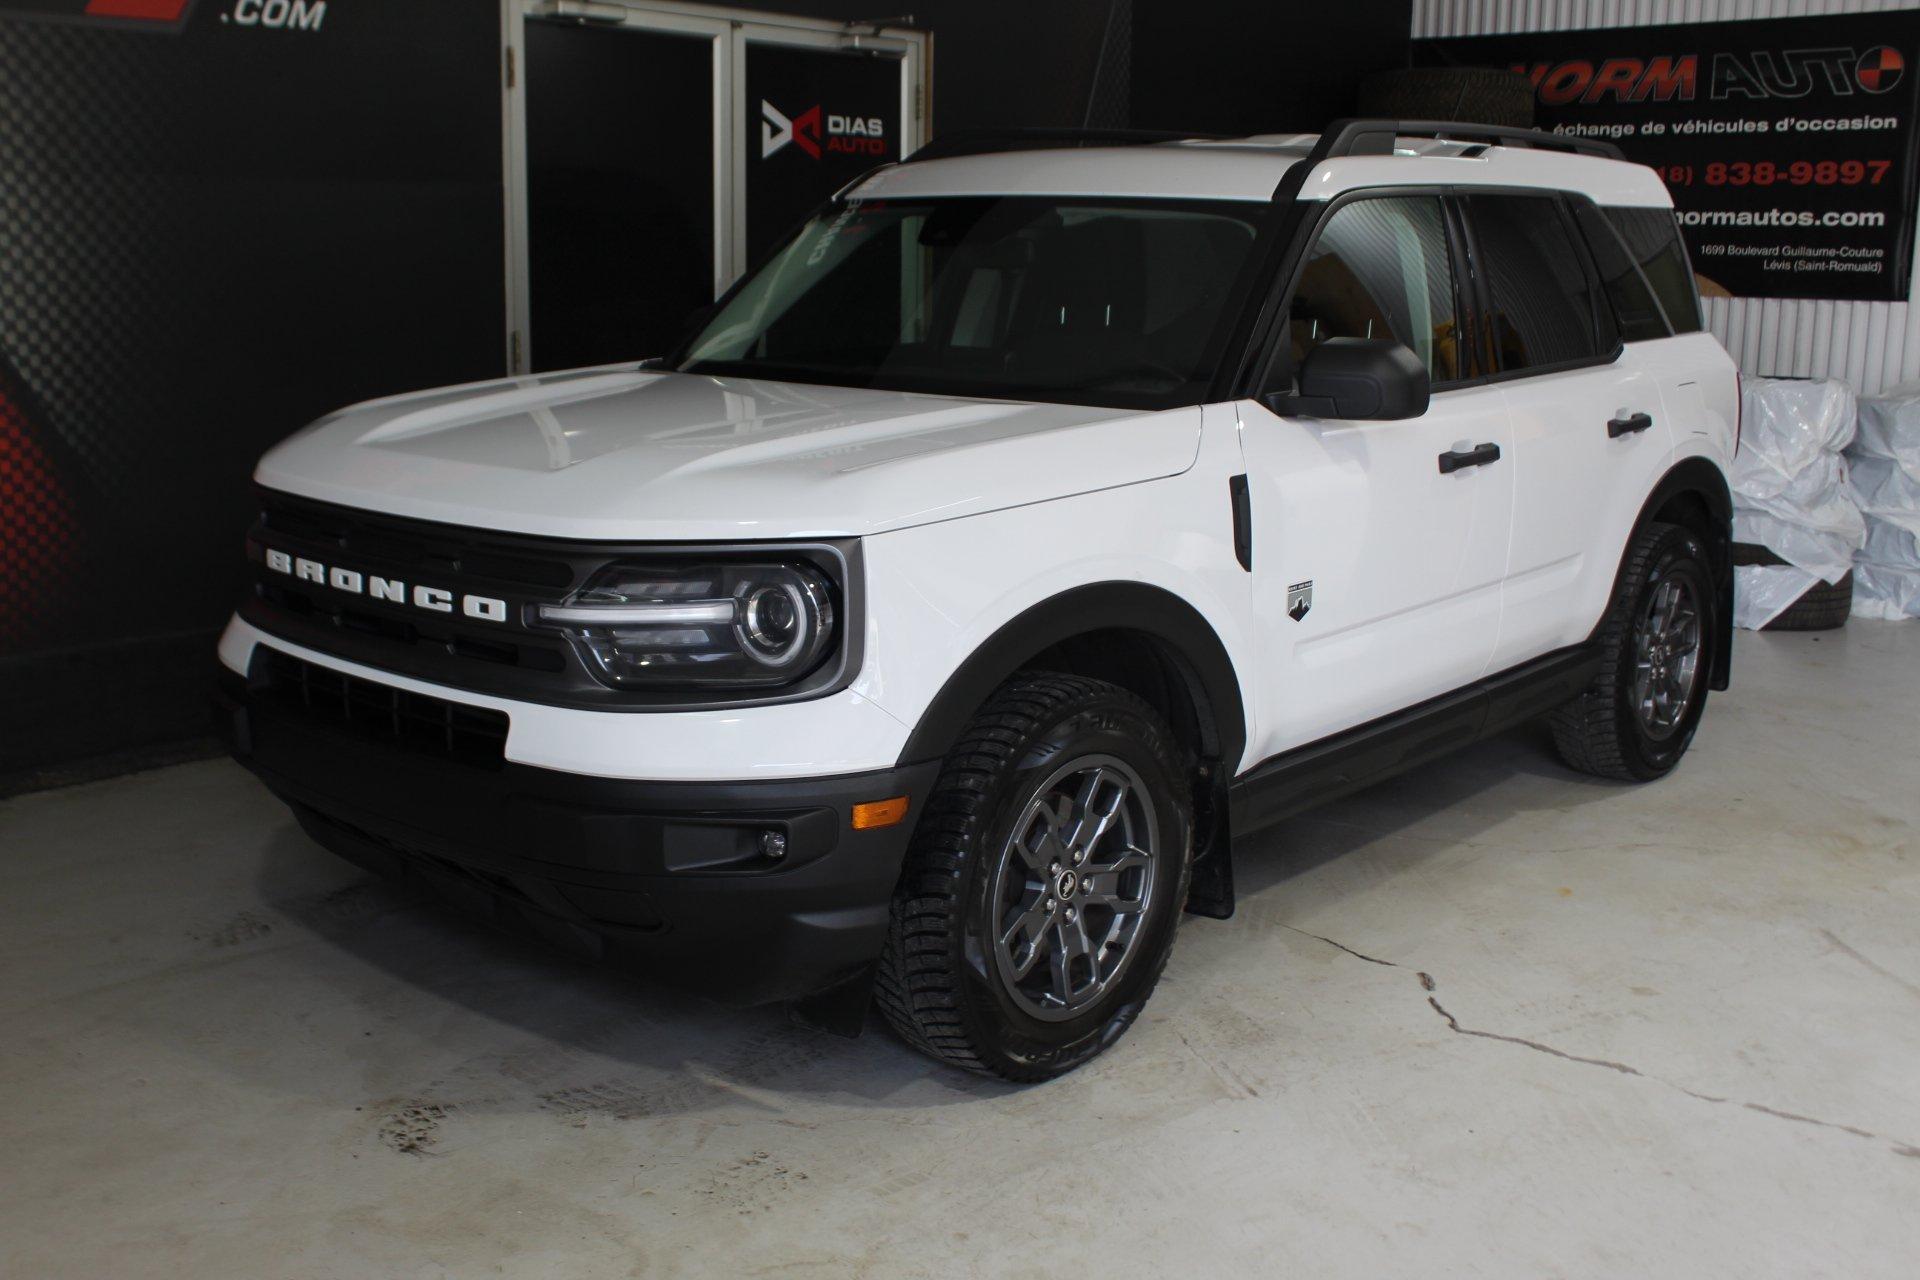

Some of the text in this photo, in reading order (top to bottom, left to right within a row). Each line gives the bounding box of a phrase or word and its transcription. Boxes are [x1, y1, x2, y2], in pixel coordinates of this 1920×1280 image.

[220, 0, 326, 31] .COM
[827, 115, 883, 136] DIAS
[1553, 120, 1635, 138] échange
[1641, 120, 1666, 135] de
[1672, 118, 1769, 135] véhicules
[1776, 115, 1898, 132] d'occasion
[827, 138, 886, 155] AUTO
[1704, 160, 1892, 187] 838-9897
[1701, 245, 1884, 258] 1699 Boulevard Guillaume-Couture
[1764, 259, 1883, 274] Lévis (Saint-Romuald)
[265, 547, 507, 622] BRONCO
